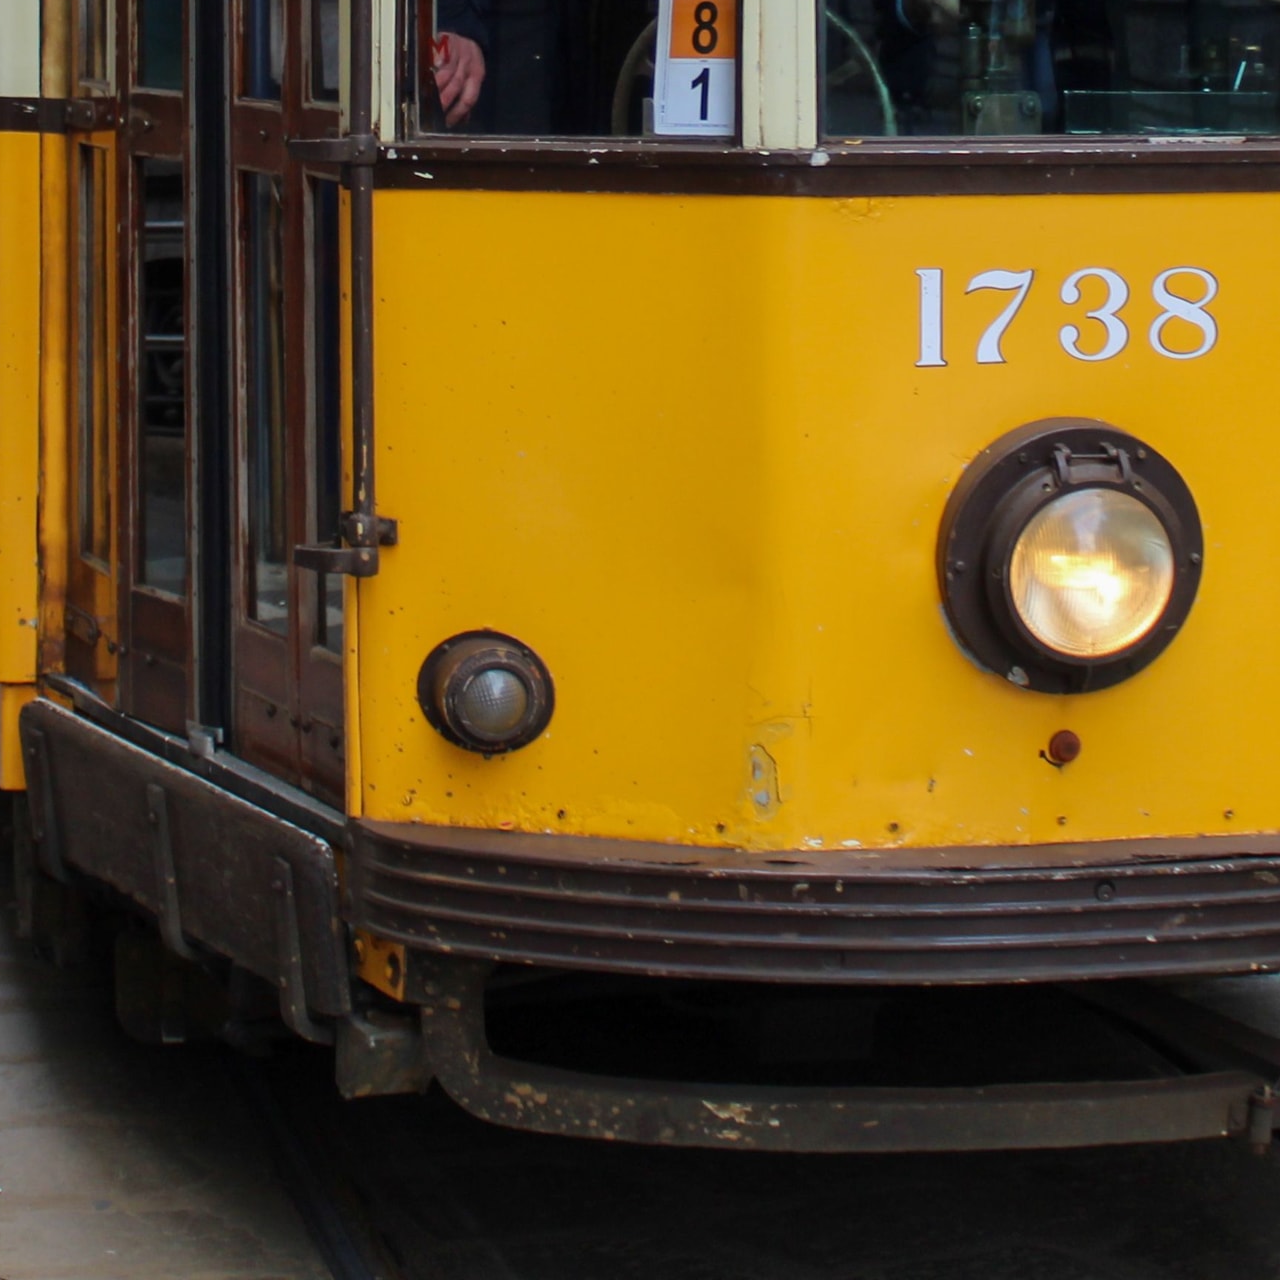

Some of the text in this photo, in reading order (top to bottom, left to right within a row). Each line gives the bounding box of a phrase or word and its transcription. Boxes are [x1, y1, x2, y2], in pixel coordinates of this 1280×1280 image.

[691, 0, 719, 55] 8
[690, 67, 710, 121] 1
[914, 265, 1220, 368] 1738
